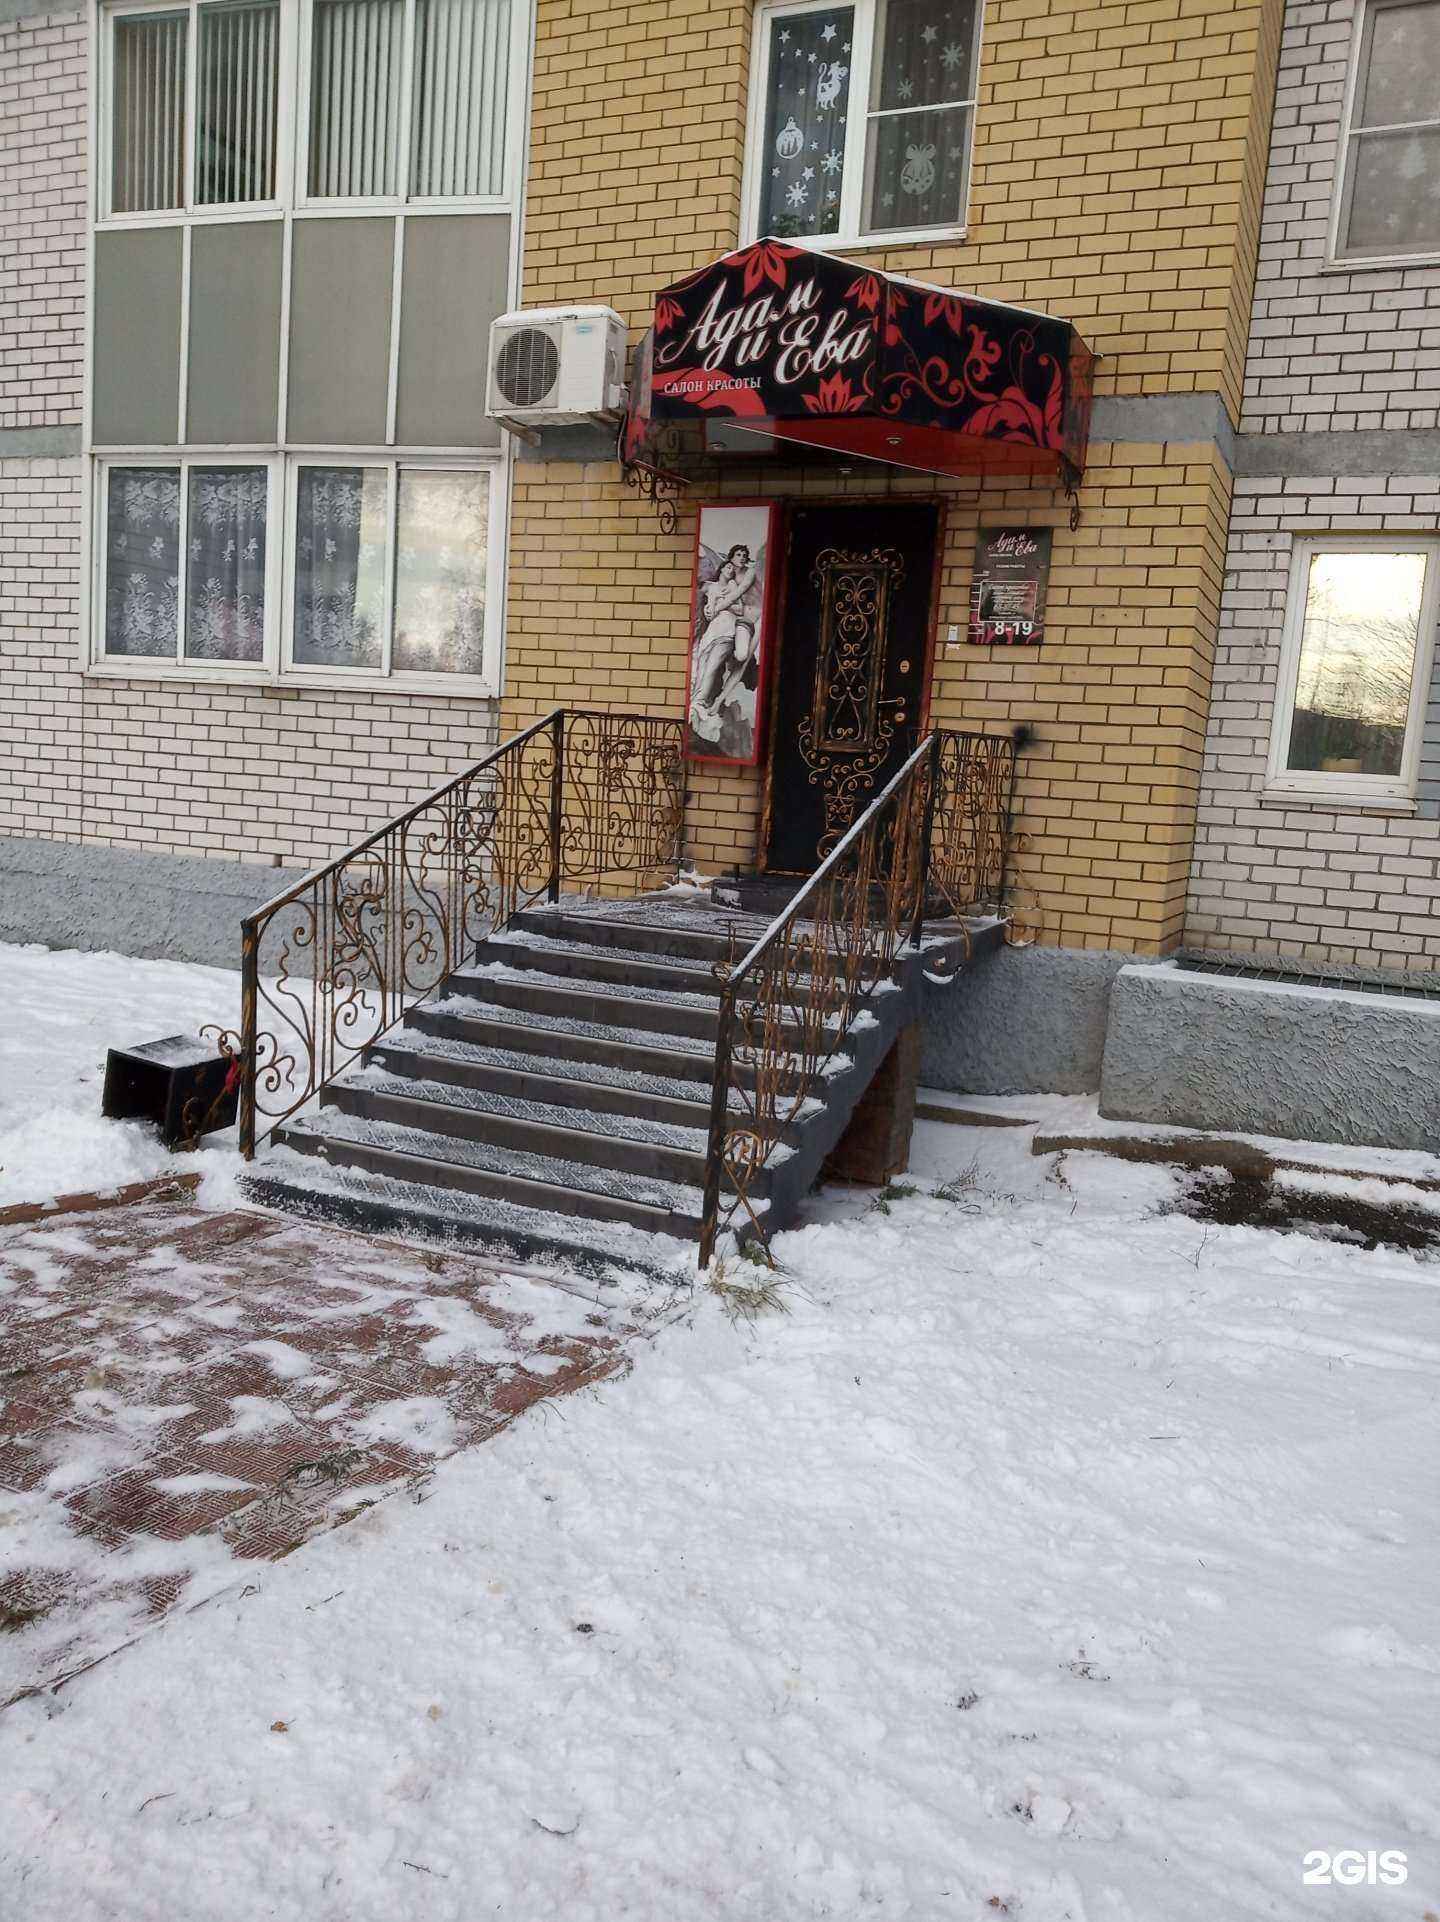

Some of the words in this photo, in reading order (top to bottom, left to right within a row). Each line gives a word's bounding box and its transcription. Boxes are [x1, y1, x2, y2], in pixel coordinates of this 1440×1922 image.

[656, 277, 822, 372] Адам
[736, 332, 771, 366] и
[774, 309, 871, 384] Ева
[664, 379, 704, 394] САЛОН
[707, 376, 761, 392] КРАСОТЫ
[995, 621, 1033, 635] 8-19
